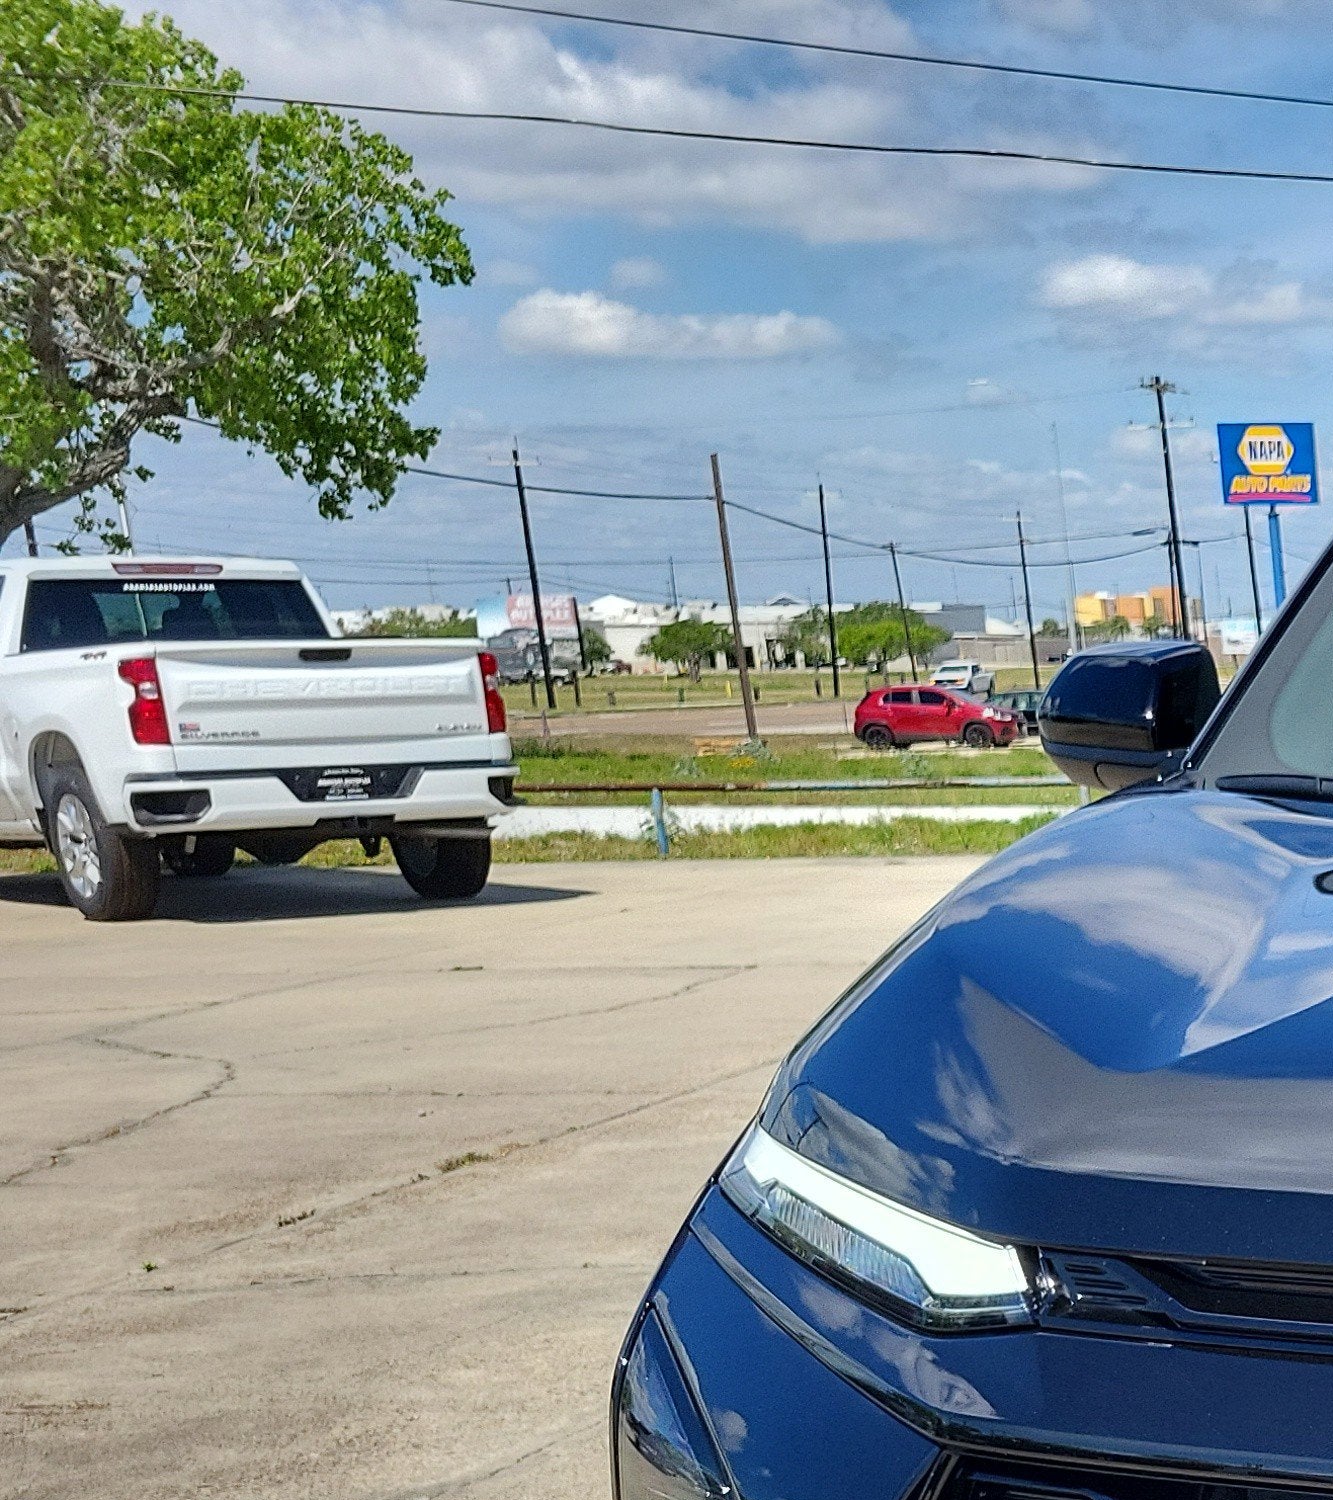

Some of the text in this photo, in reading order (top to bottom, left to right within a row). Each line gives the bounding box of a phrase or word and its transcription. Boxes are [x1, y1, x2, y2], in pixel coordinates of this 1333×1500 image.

[1248, 441, 1285, 460] NAPA
[1230, 474, 1311, 494] AUTO PARTS
